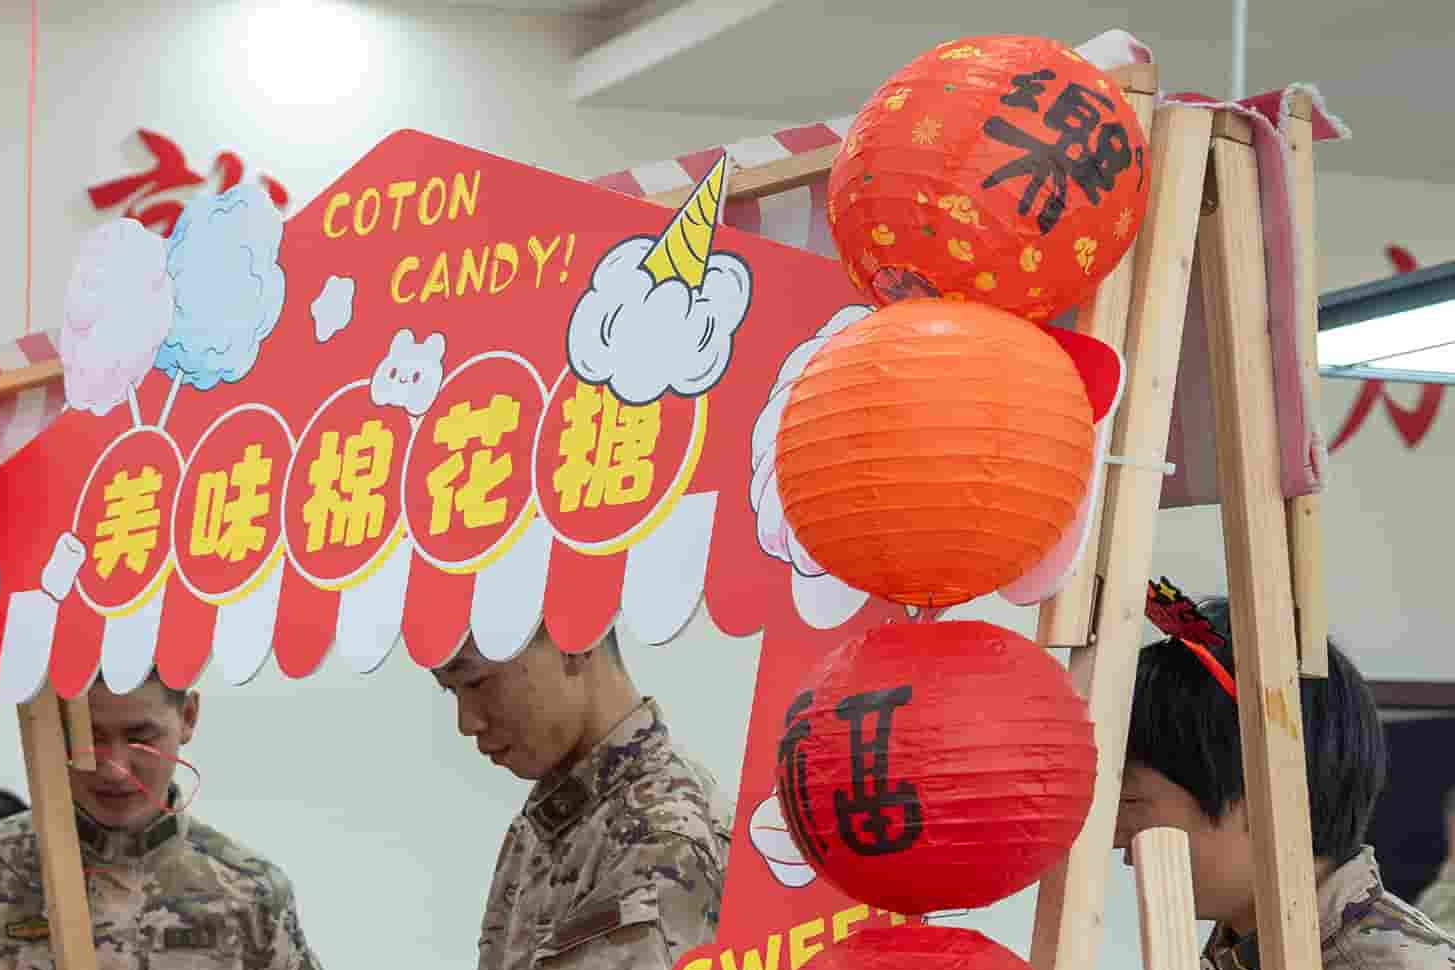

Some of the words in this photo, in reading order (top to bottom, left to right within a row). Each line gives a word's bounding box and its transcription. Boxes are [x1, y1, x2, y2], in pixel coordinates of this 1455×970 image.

[323, 170, 481, 239] COTON
[390, 234, 578, 305] CANDY!
[92, 383, 662, 579] 美味棉花糖
